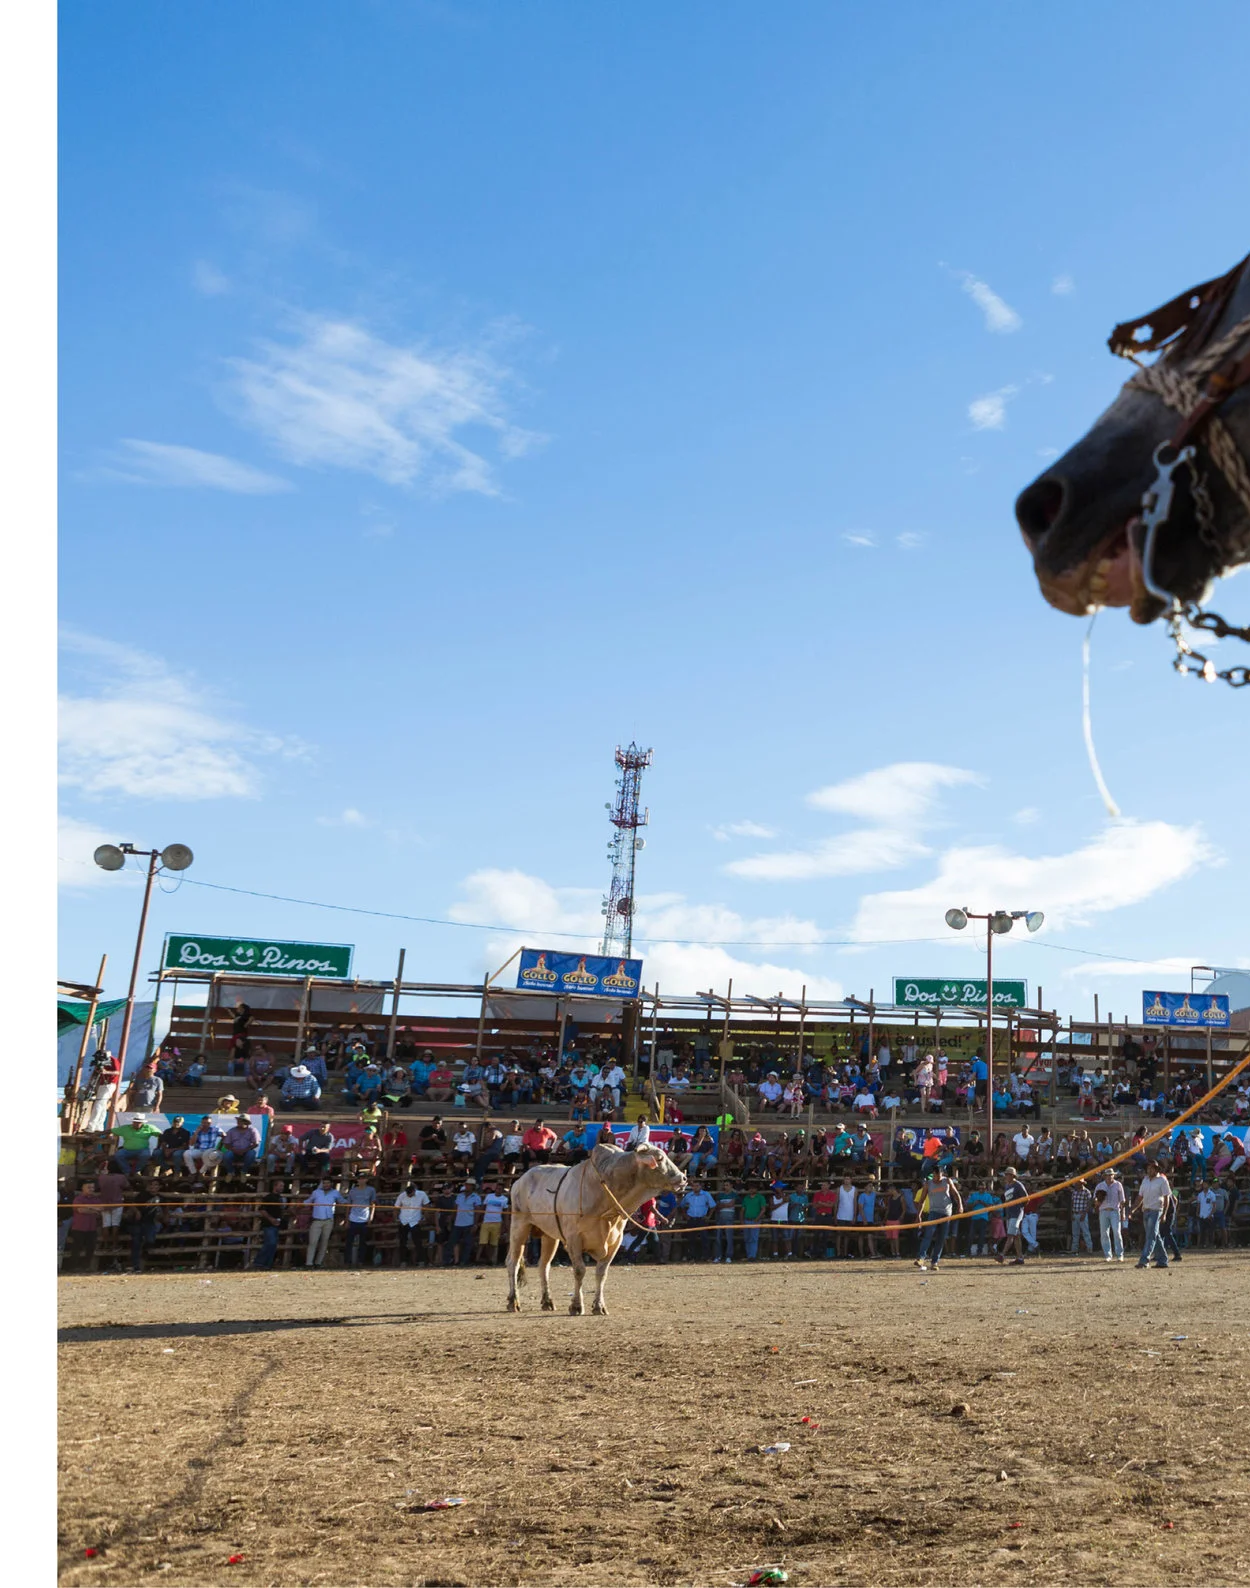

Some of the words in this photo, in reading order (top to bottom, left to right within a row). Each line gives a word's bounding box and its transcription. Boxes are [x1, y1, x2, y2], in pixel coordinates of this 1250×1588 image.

[179, 942, 230, 966] Dos
[257, 946, 338, 972] Pinos
[522, 970, 557, 981] GOLLO
[563, 973, 597, 985] GOLLO
[603, 976, 636, 988] GOLLO
[905, 984, 941, 1001] Dos
